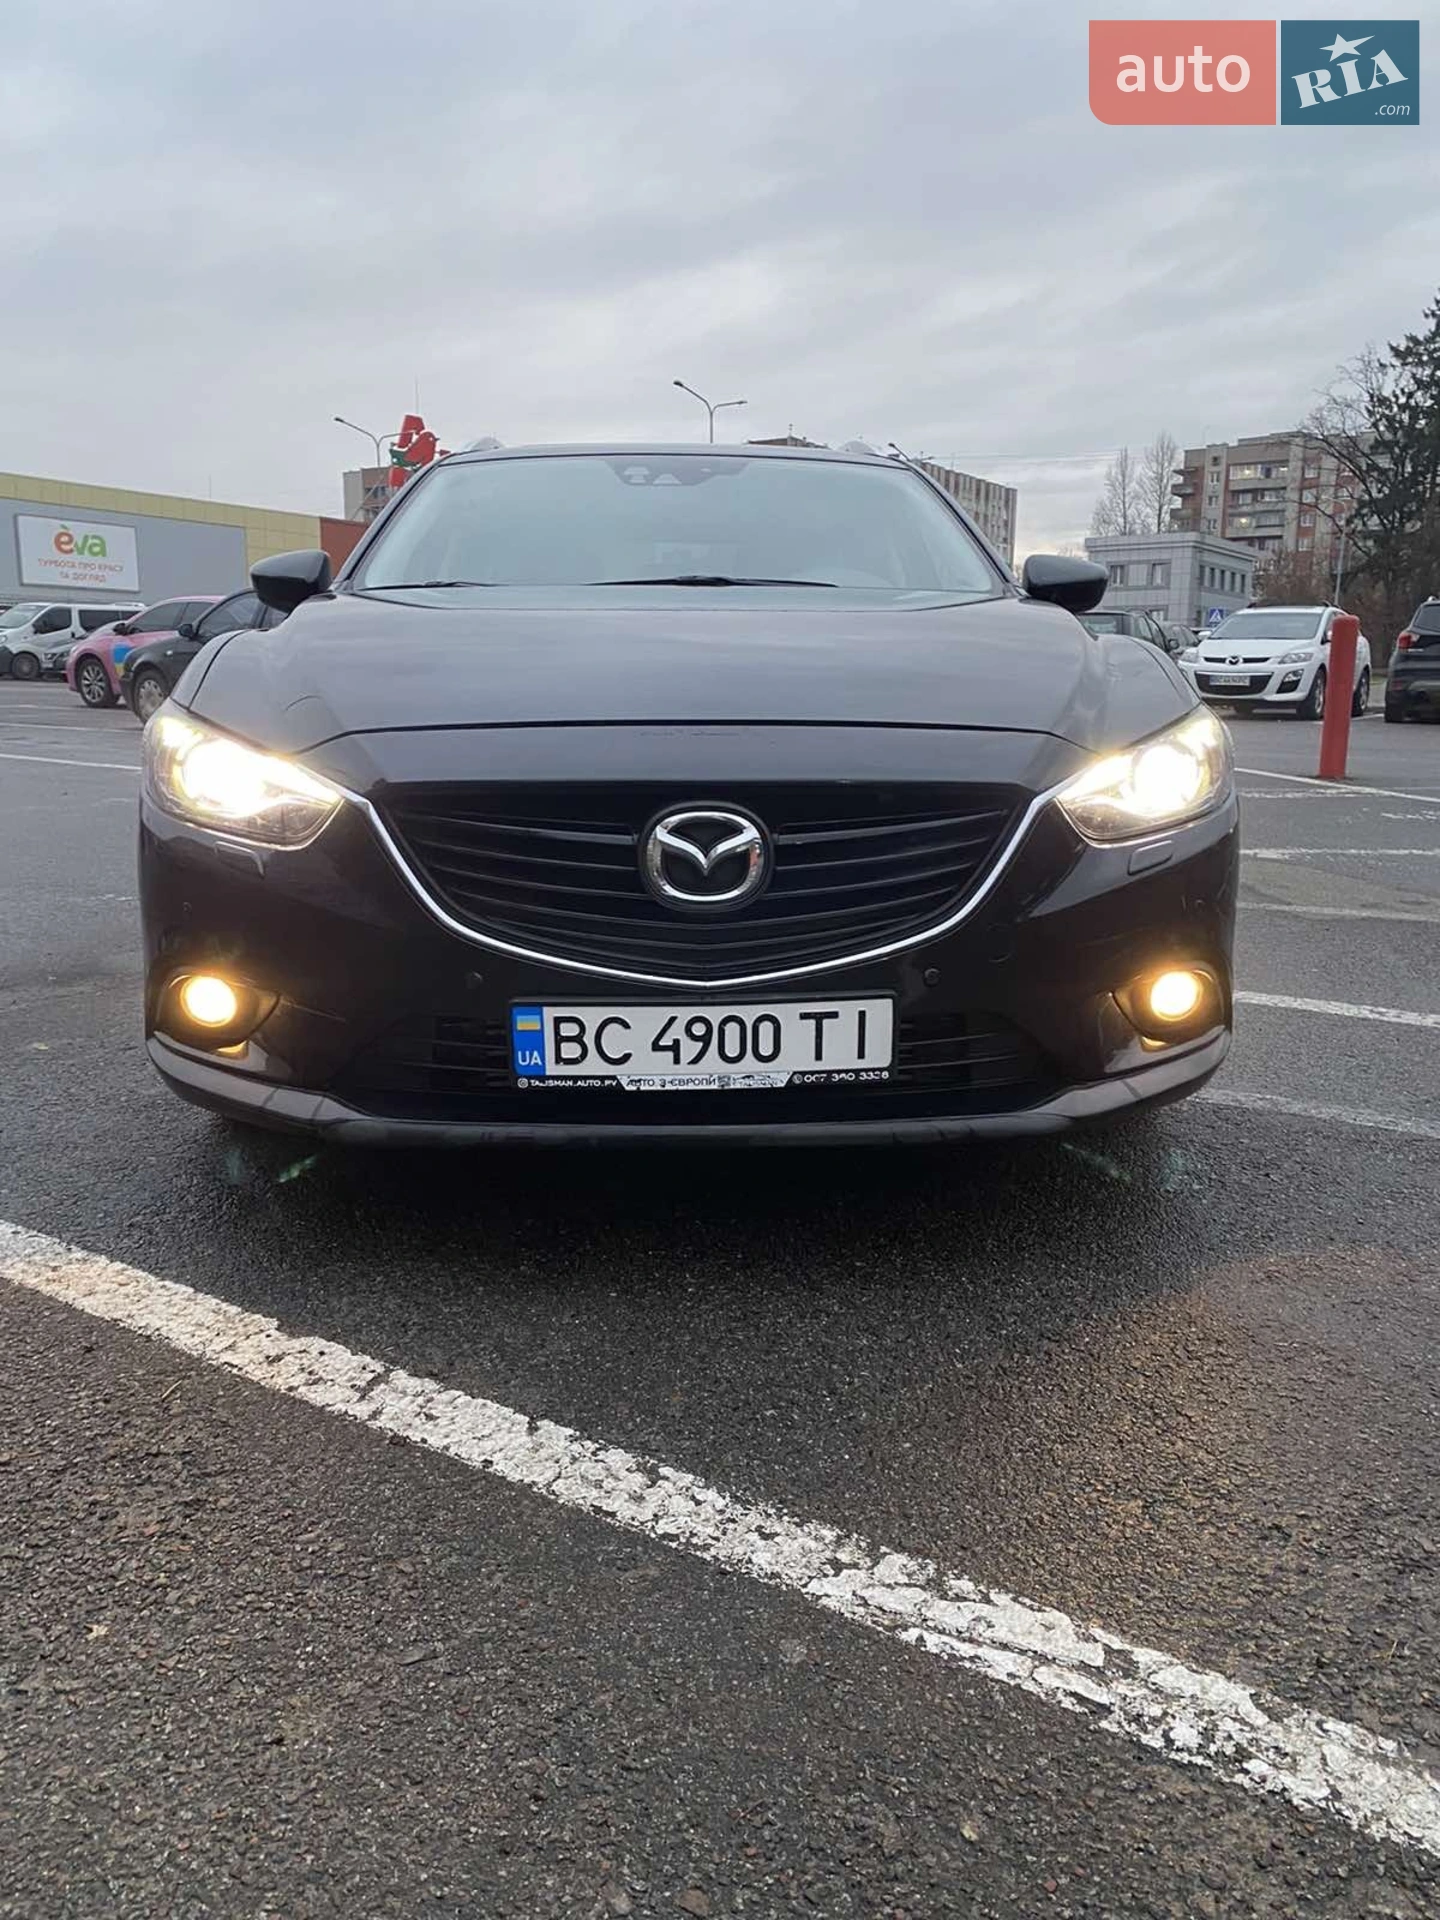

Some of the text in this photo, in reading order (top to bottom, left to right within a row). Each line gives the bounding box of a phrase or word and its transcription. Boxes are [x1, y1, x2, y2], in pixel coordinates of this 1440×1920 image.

[517, 1010, 867, 1067] UA BC 4900 TI
